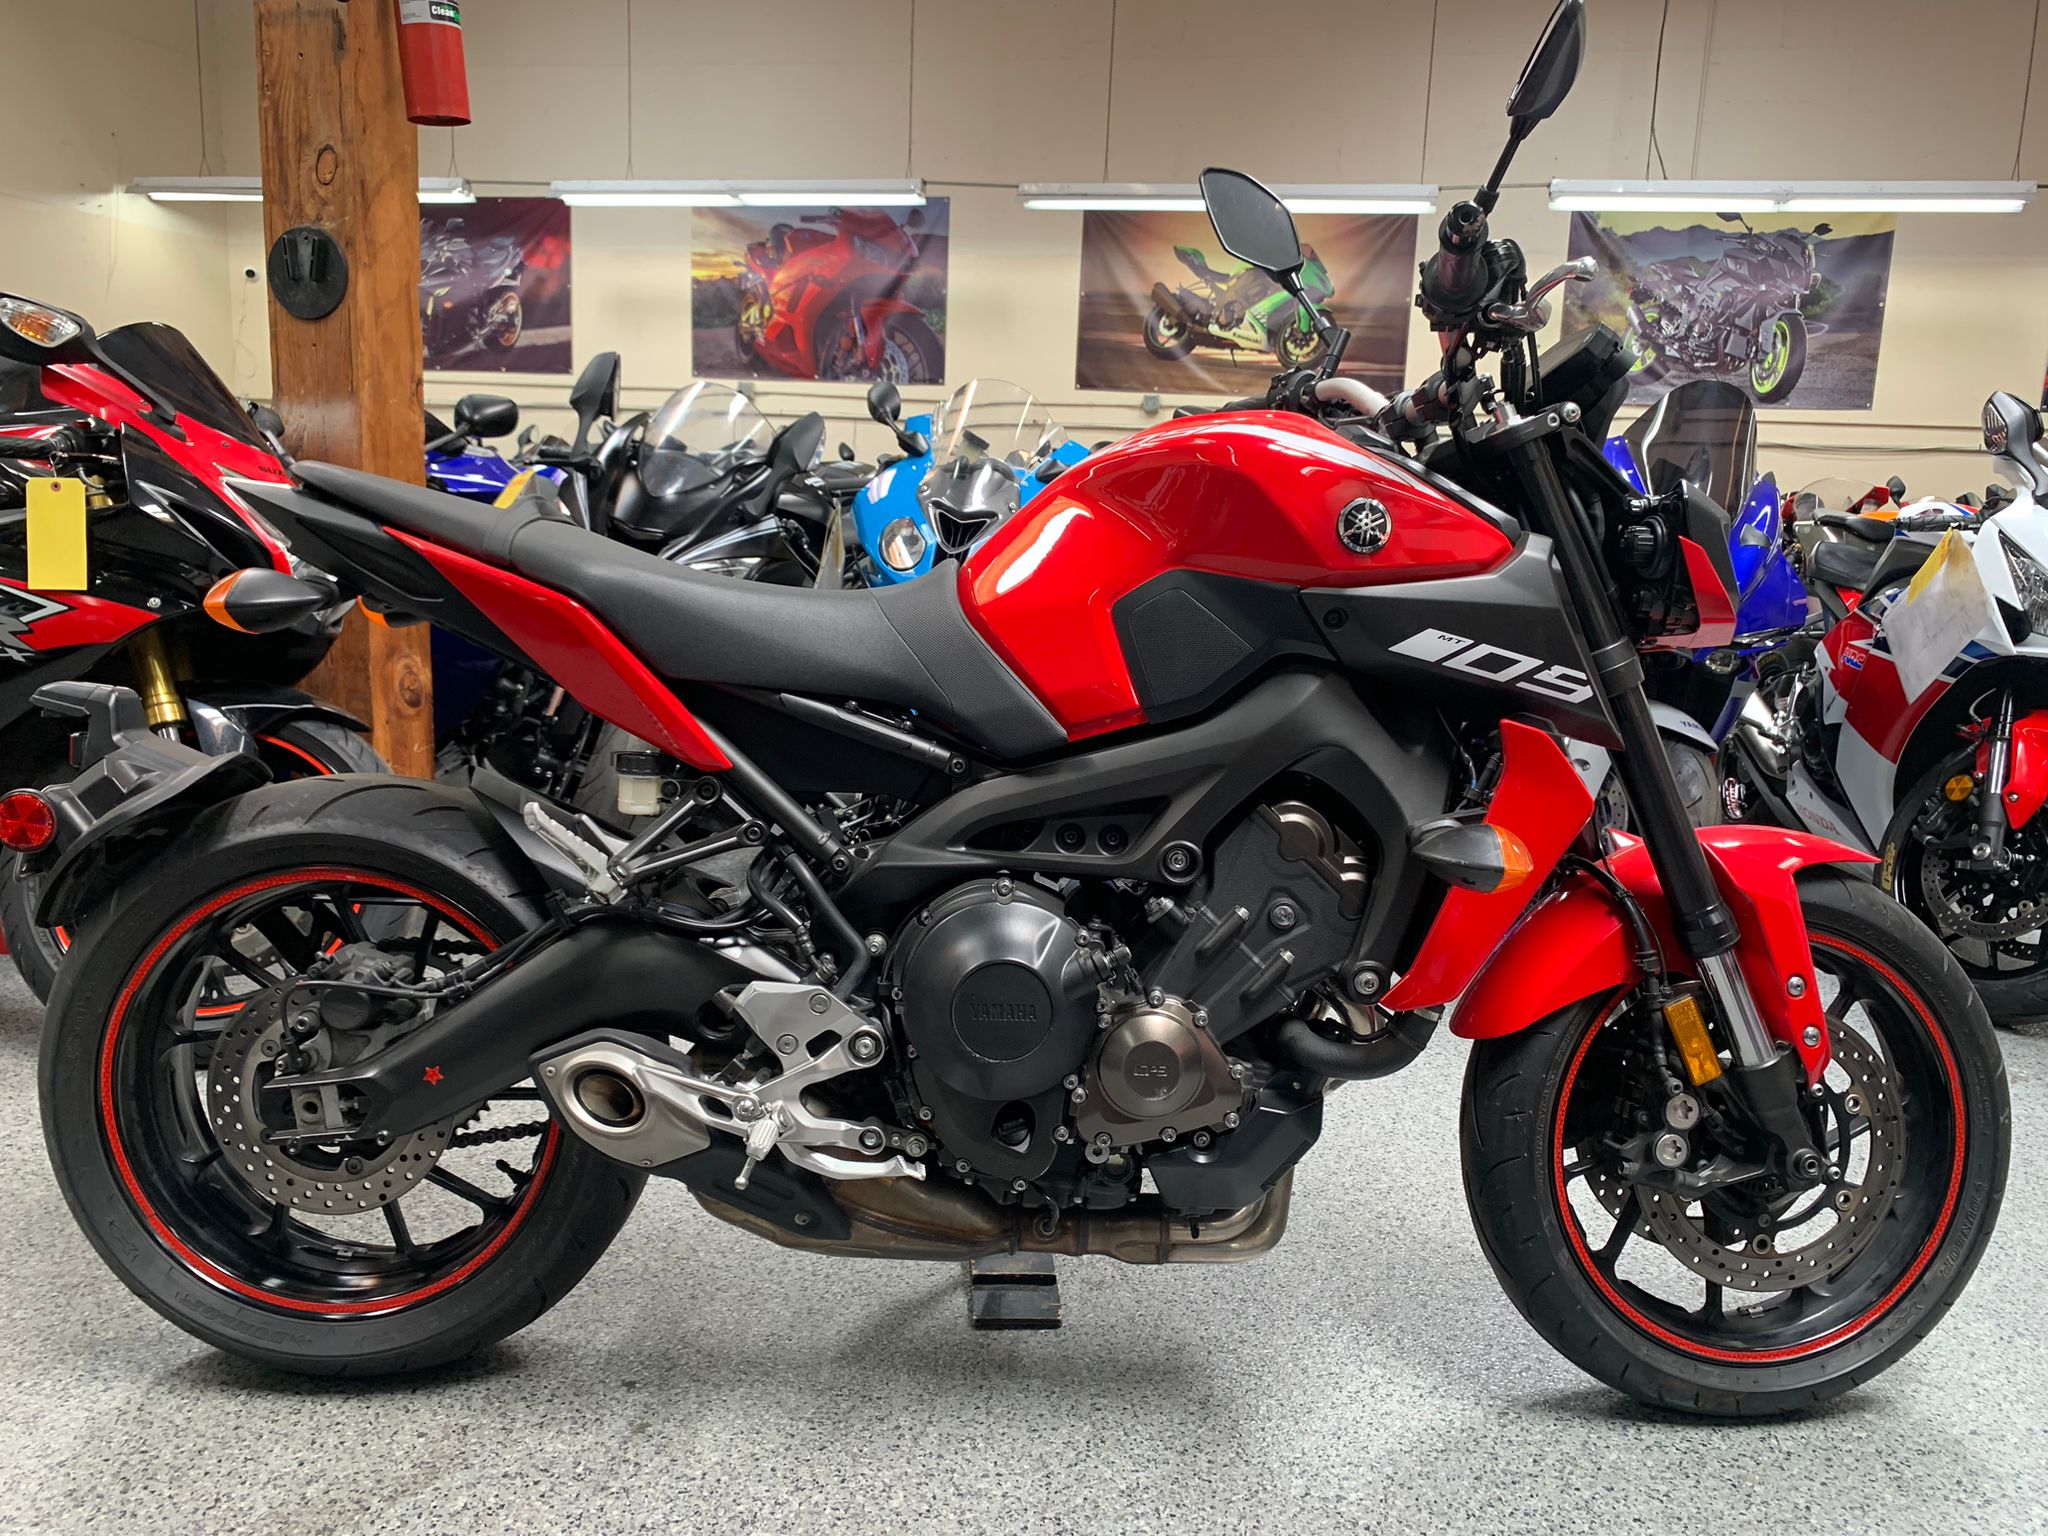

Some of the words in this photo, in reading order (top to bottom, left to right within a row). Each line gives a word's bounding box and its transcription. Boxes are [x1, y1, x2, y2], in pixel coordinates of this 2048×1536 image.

[431, 5, 455, 18] Clean
[1436, 634, 1467, 645] MT
[1796, 803, 1841, 835] HONDA
[969, 1002, 1037, 1022] YAMAHA
